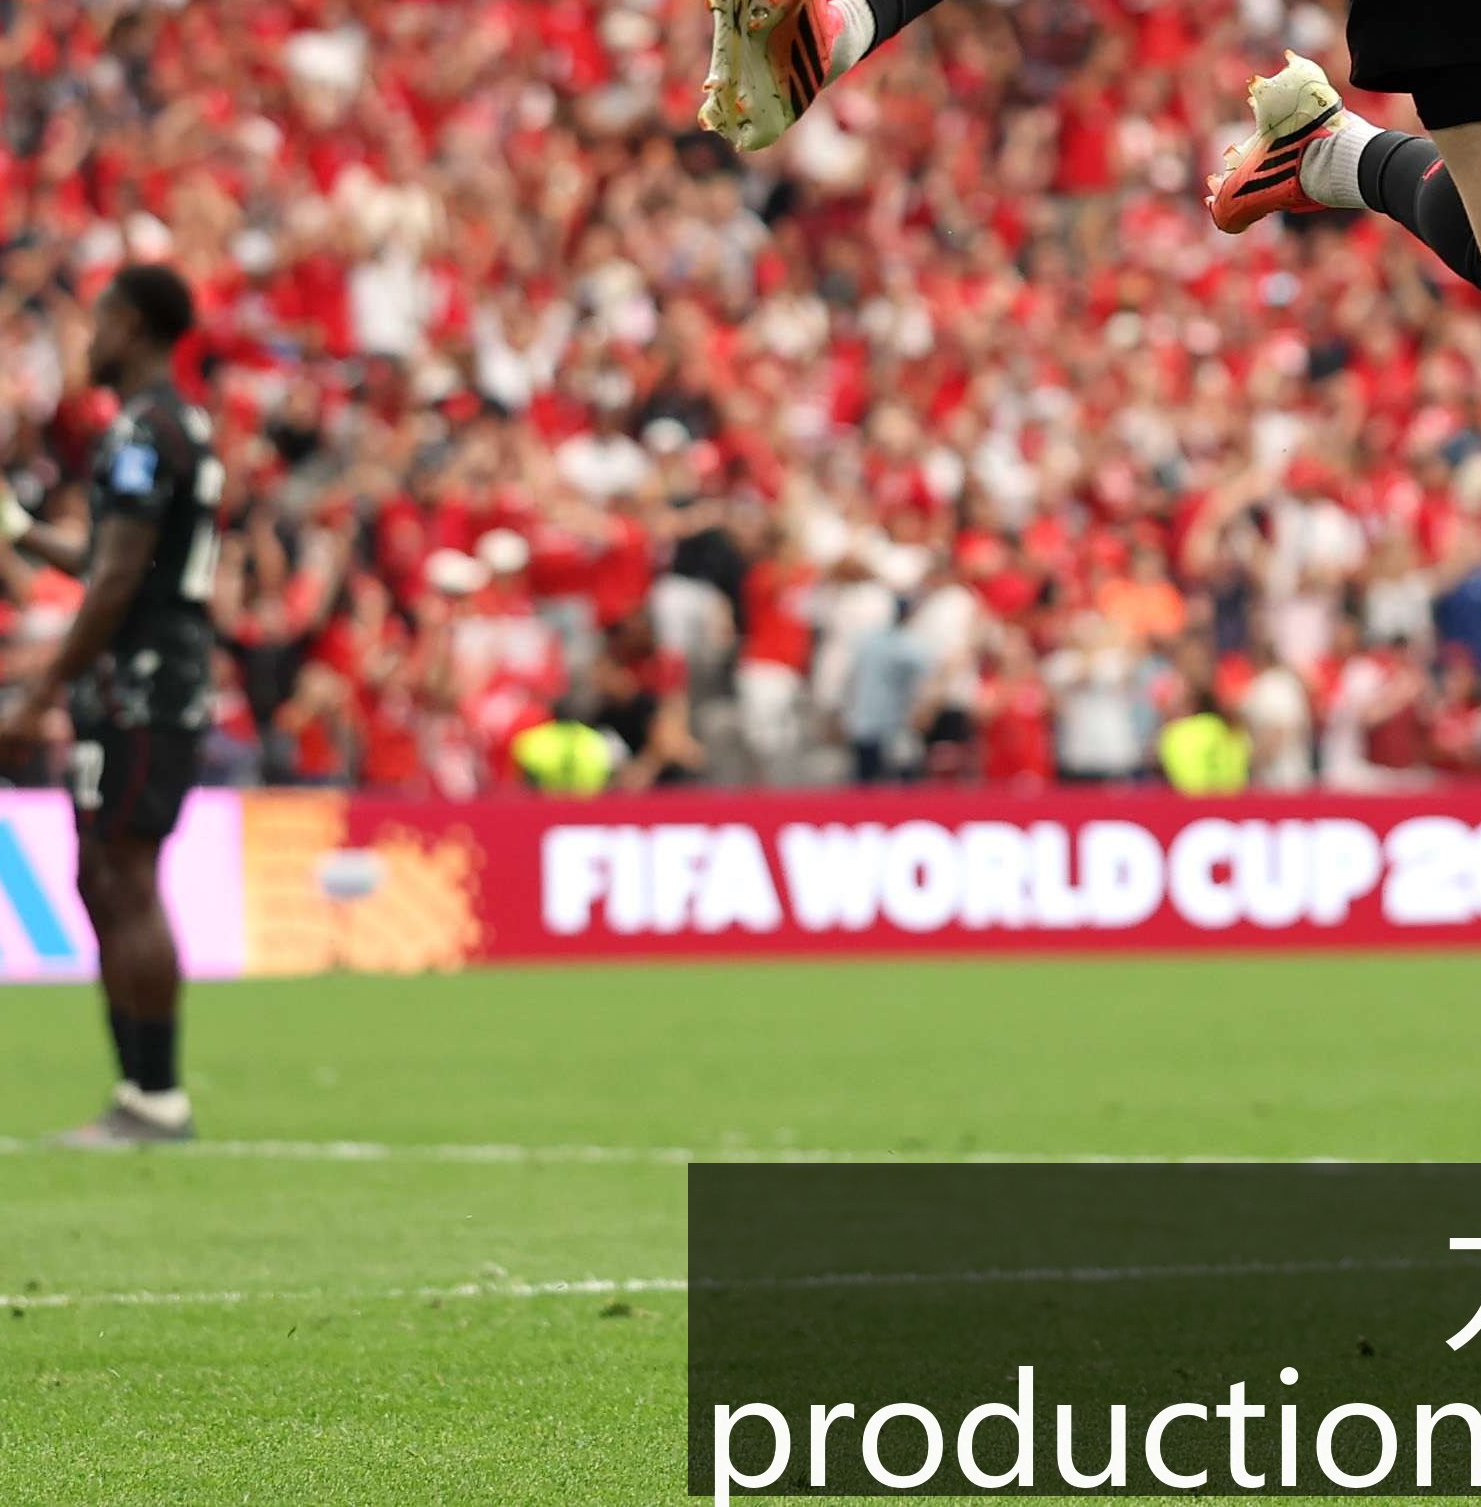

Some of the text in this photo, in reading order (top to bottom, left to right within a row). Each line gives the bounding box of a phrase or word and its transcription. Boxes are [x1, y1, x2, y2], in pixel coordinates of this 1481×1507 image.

[542, 825, 783, 933] FIFA
[777, 819, 1165, 931] WORLD
[1168, 818, 1381, 929] CUP
